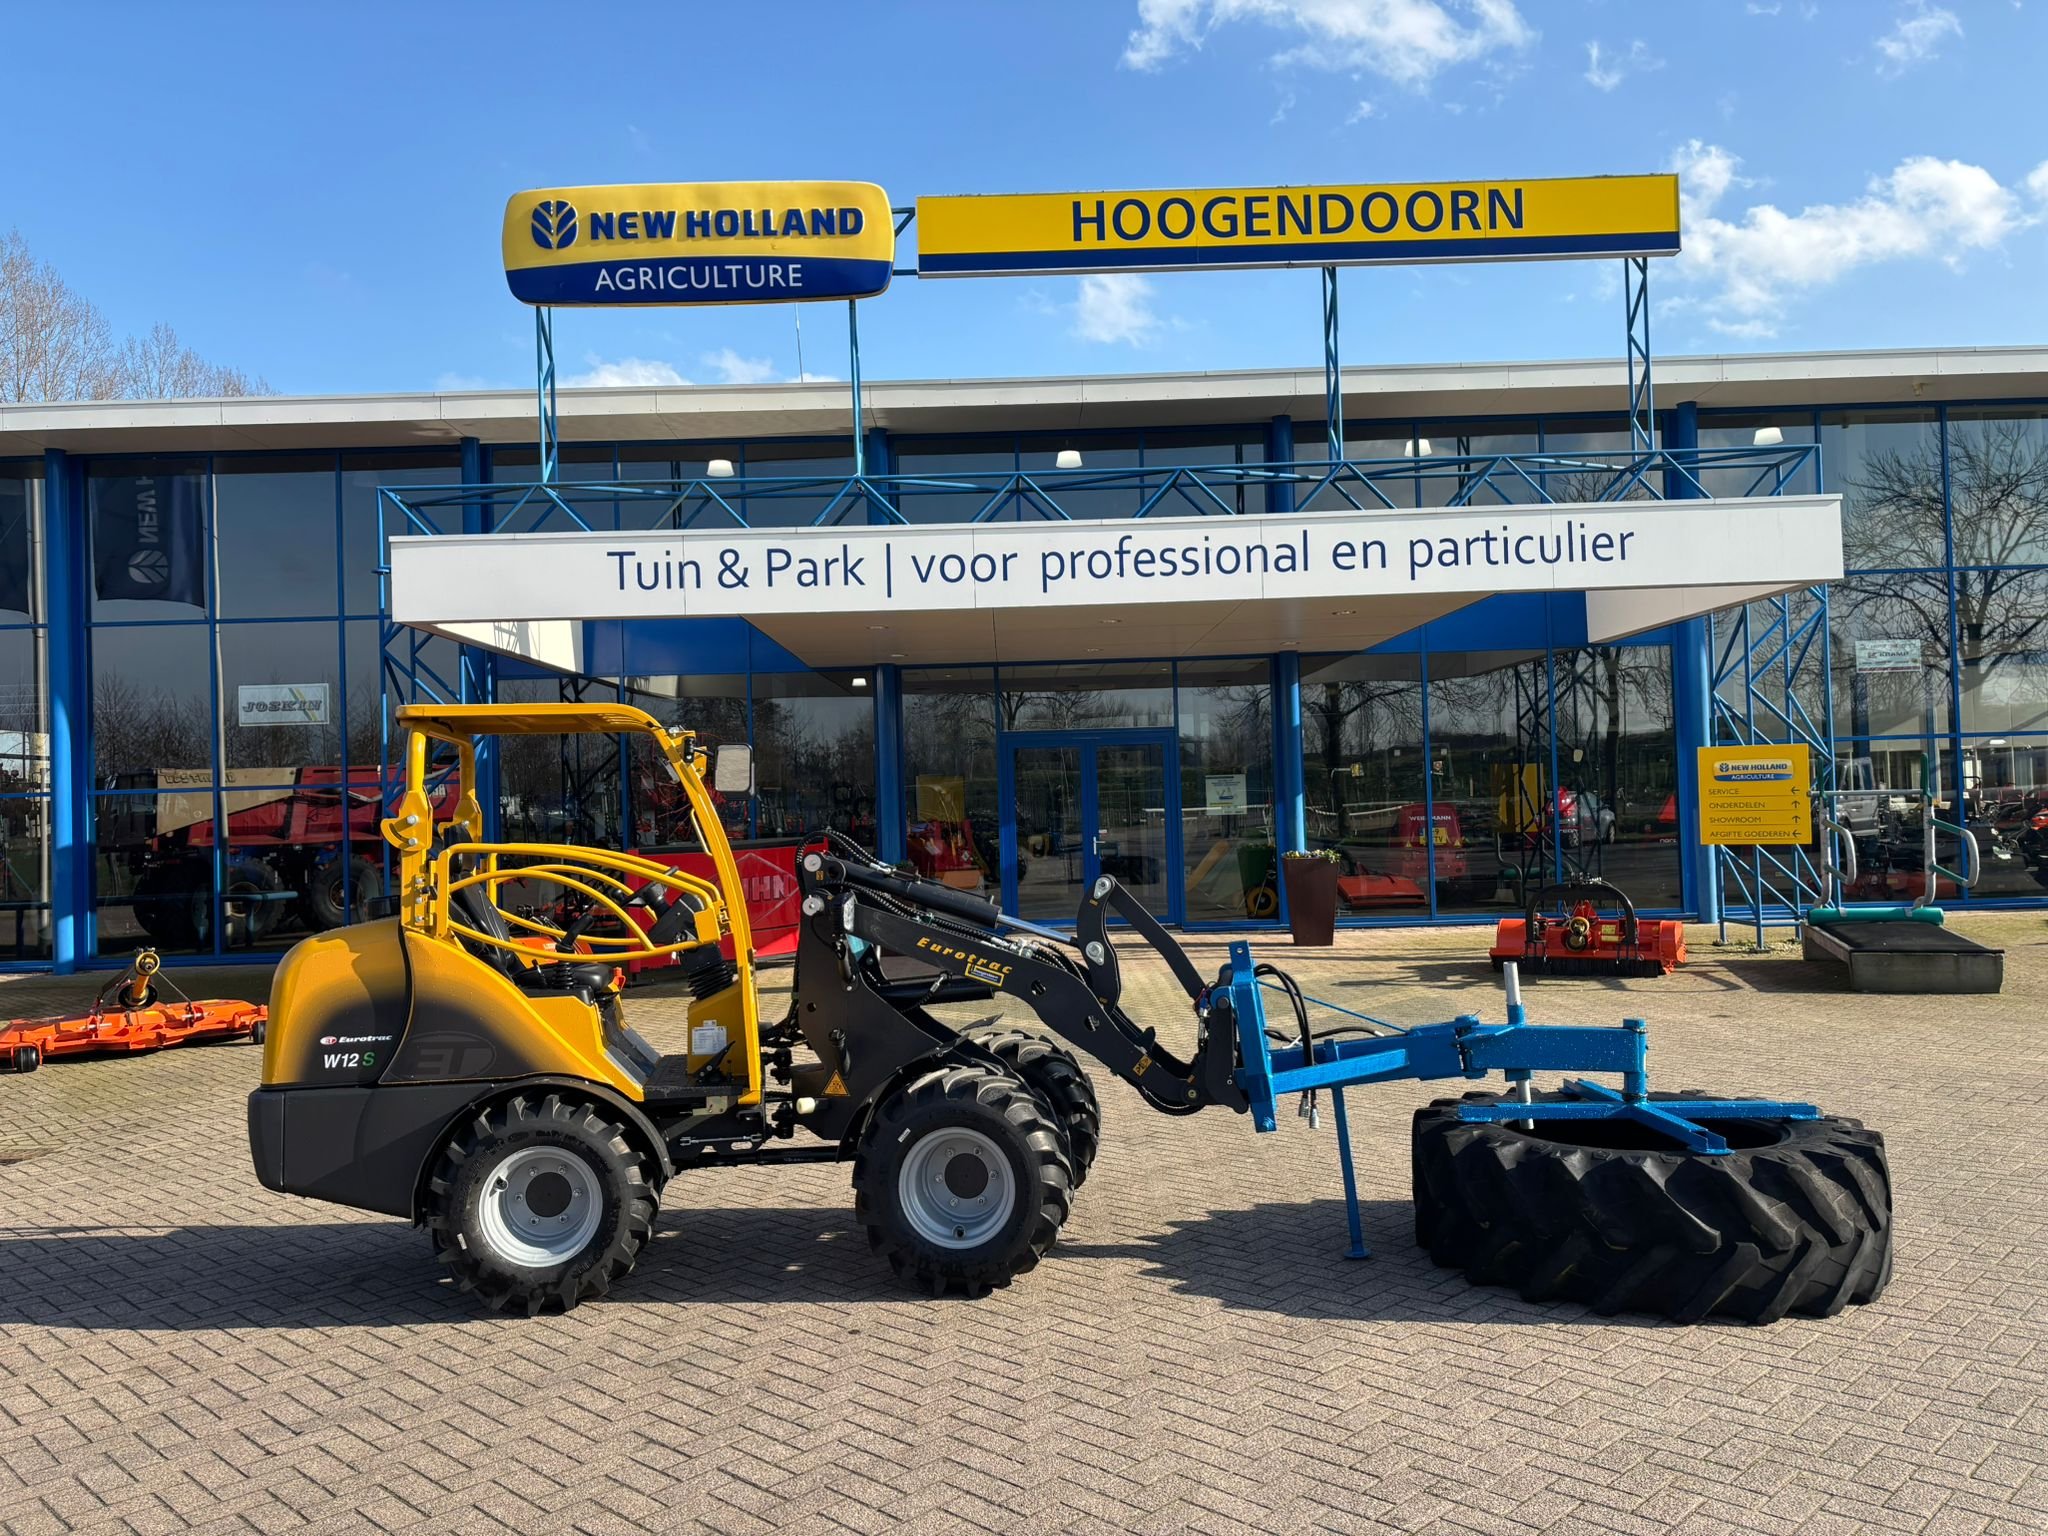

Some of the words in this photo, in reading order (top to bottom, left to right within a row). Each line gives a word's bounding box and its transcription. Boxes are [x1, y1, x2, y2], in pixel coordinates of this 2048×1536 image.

[1072, 188, 1525, 243] HOOGENDOORN
[590, 210, 676, 241] NEW
[686, 207, 864, 239] HOLLAND
[594, 263, 803, 292] AGRICULTURE
[606, 548, 701, 591] Tuin
[717, 547, 750, 589] &
[765, 544, 866, 588] Park
[911, 550, 1018, 584] voor
[1041, 529, 1310, 594] professional
[1331, 539, 1387, 570] en
[1409, 520, 1635, 581] particulier
[242, 699, 323, 713] JOSKIN
[1730, 763, 1749, 771] NEW
[1750, 762, 1788, 771] HOLLAND
[1708, 787, 1740, 795] SERVICE
[1708, 801, 1766, 809] ONDERDELEN
[1709, 816, 1762, 824] SHOWROOM
[1710, 830, 1742, 838] AFGIFTE
[1743, 829, 1791, 838] GOEDEREN
[915, 936, 1015, 974] Eurotrac
[338, 1034, 393, 1043] Eurotrac
[323, 1052, 360, 1069] W12
[361, 1051, 376, 1067] S
